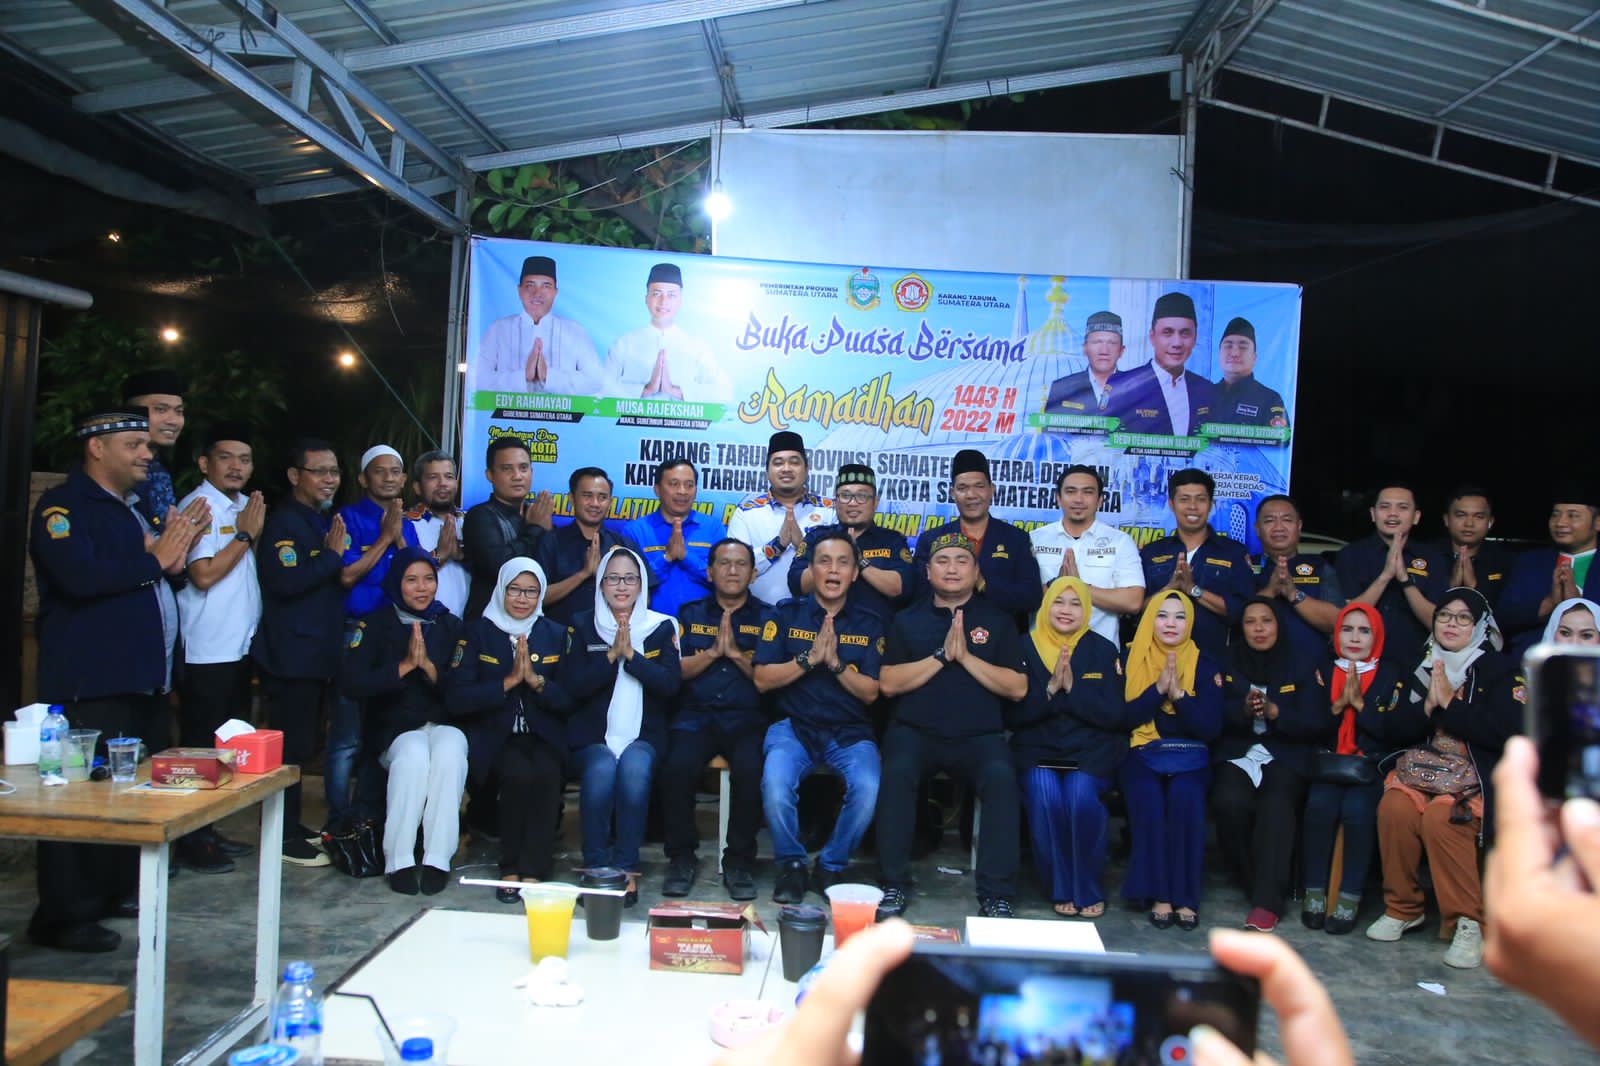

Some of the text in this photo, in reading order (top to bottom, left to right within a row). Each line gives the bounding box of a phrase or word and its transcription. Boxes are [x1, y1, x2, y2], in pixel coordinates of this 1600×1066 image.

[765, 289, 810, 297] SUMATERA
[736, 312, 809, 356] Buka
[496, 394, 572, 410] EDY RAHMAYADI
[616, 400, 704, 417] MUSA RAJEKSHAH
[738, 366, 934, 436] Ramadhan
[953, 384, 1018, 410] 1443 H
[940, 408, 1014, 434] 2022 M
[530, 442, 557, 454] KOTA
[640, 439, 711, 464] KARANG
[716, 443, 768, 468] TARUN
[806, 449, 872, 472] ROVINSI
[878, 453, 953, 478] SUMATE
[988, 458, 1035, 483] TARA
[625, 463, 660, 486] KAR
[702, 468, 768, 492] TARUNA
[990, 484, 1060, 510] MATERA
[1233, 482, 1264, 491] CERDAS
